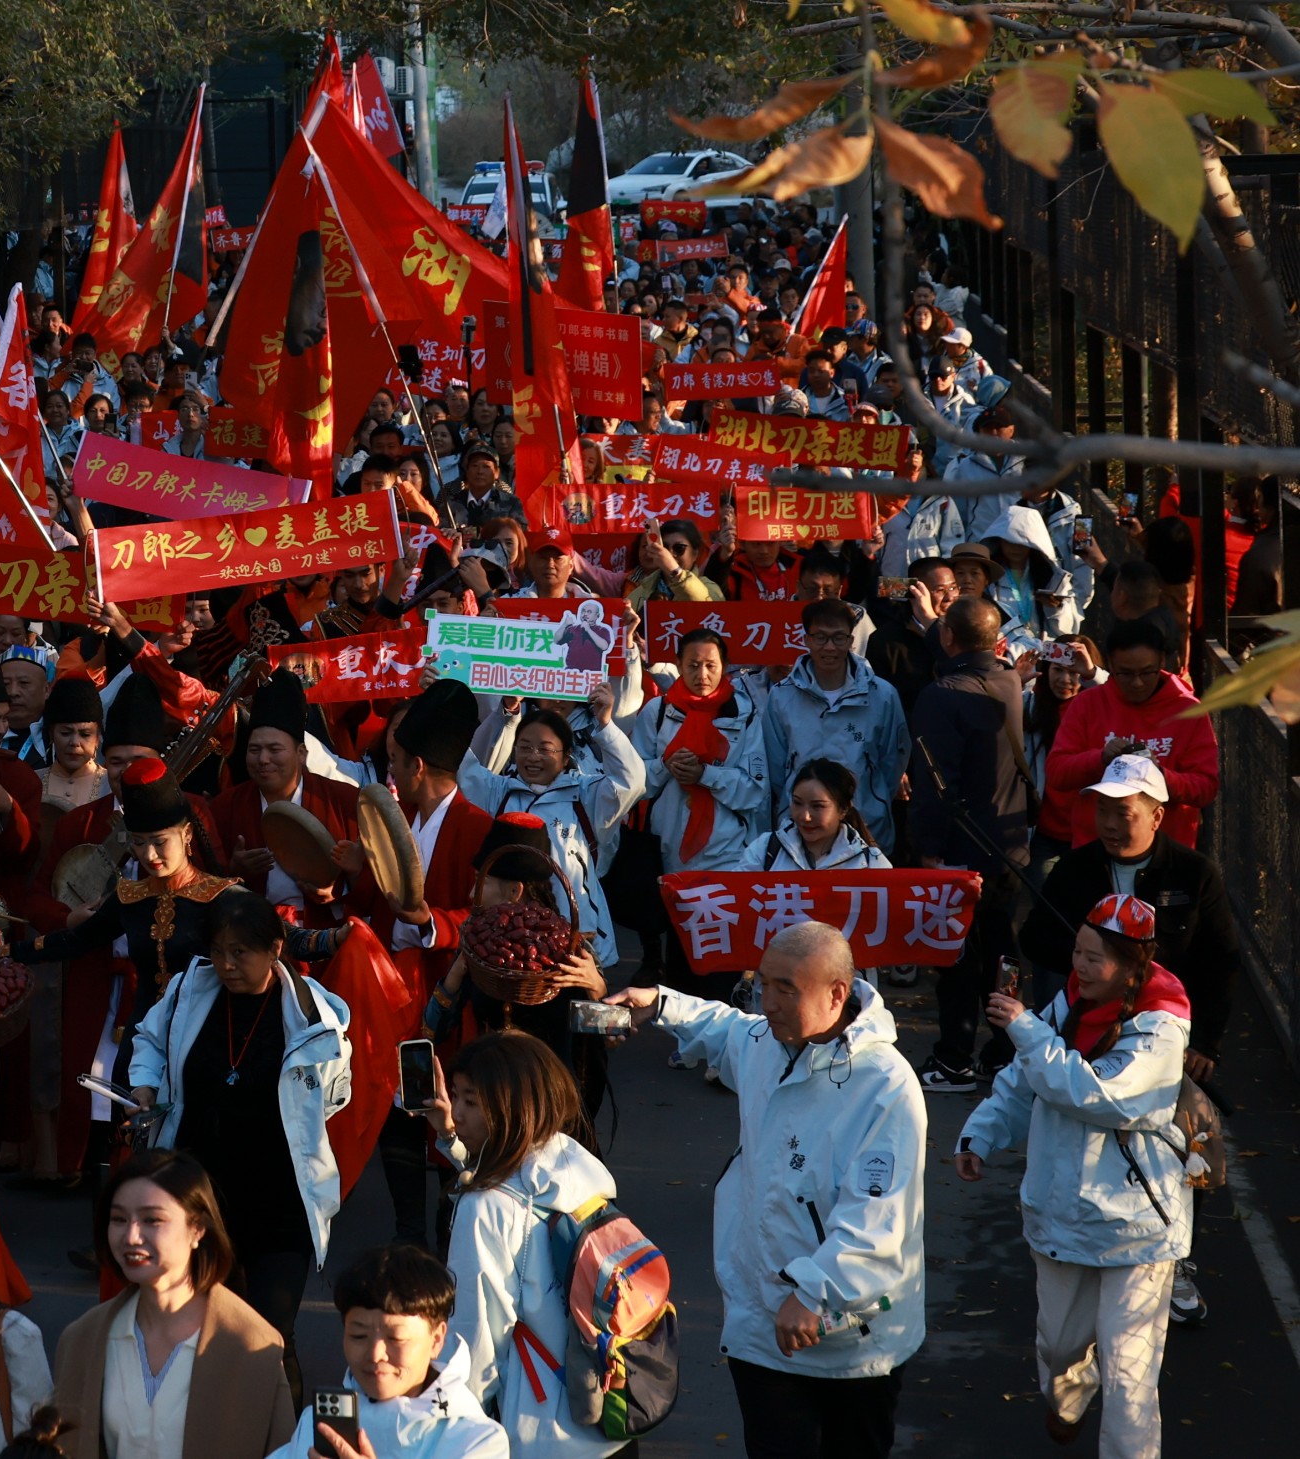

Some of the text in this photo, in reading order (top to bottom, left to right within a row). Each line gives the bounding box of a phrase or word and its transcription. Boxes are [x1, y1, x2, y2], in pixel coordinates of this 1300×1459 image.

[714, 414, 900, 468] 湖北刀亲联盟
[600, 491, 716, 520] 重庆刀迷
[747, 490, 857, 520] 印尼刀迷
[438, 621, 555, 654] 爱是你我
[471, 664, 603, 696] 用心交织的生活
[675, 882, 966, 960] 香港刀迷
